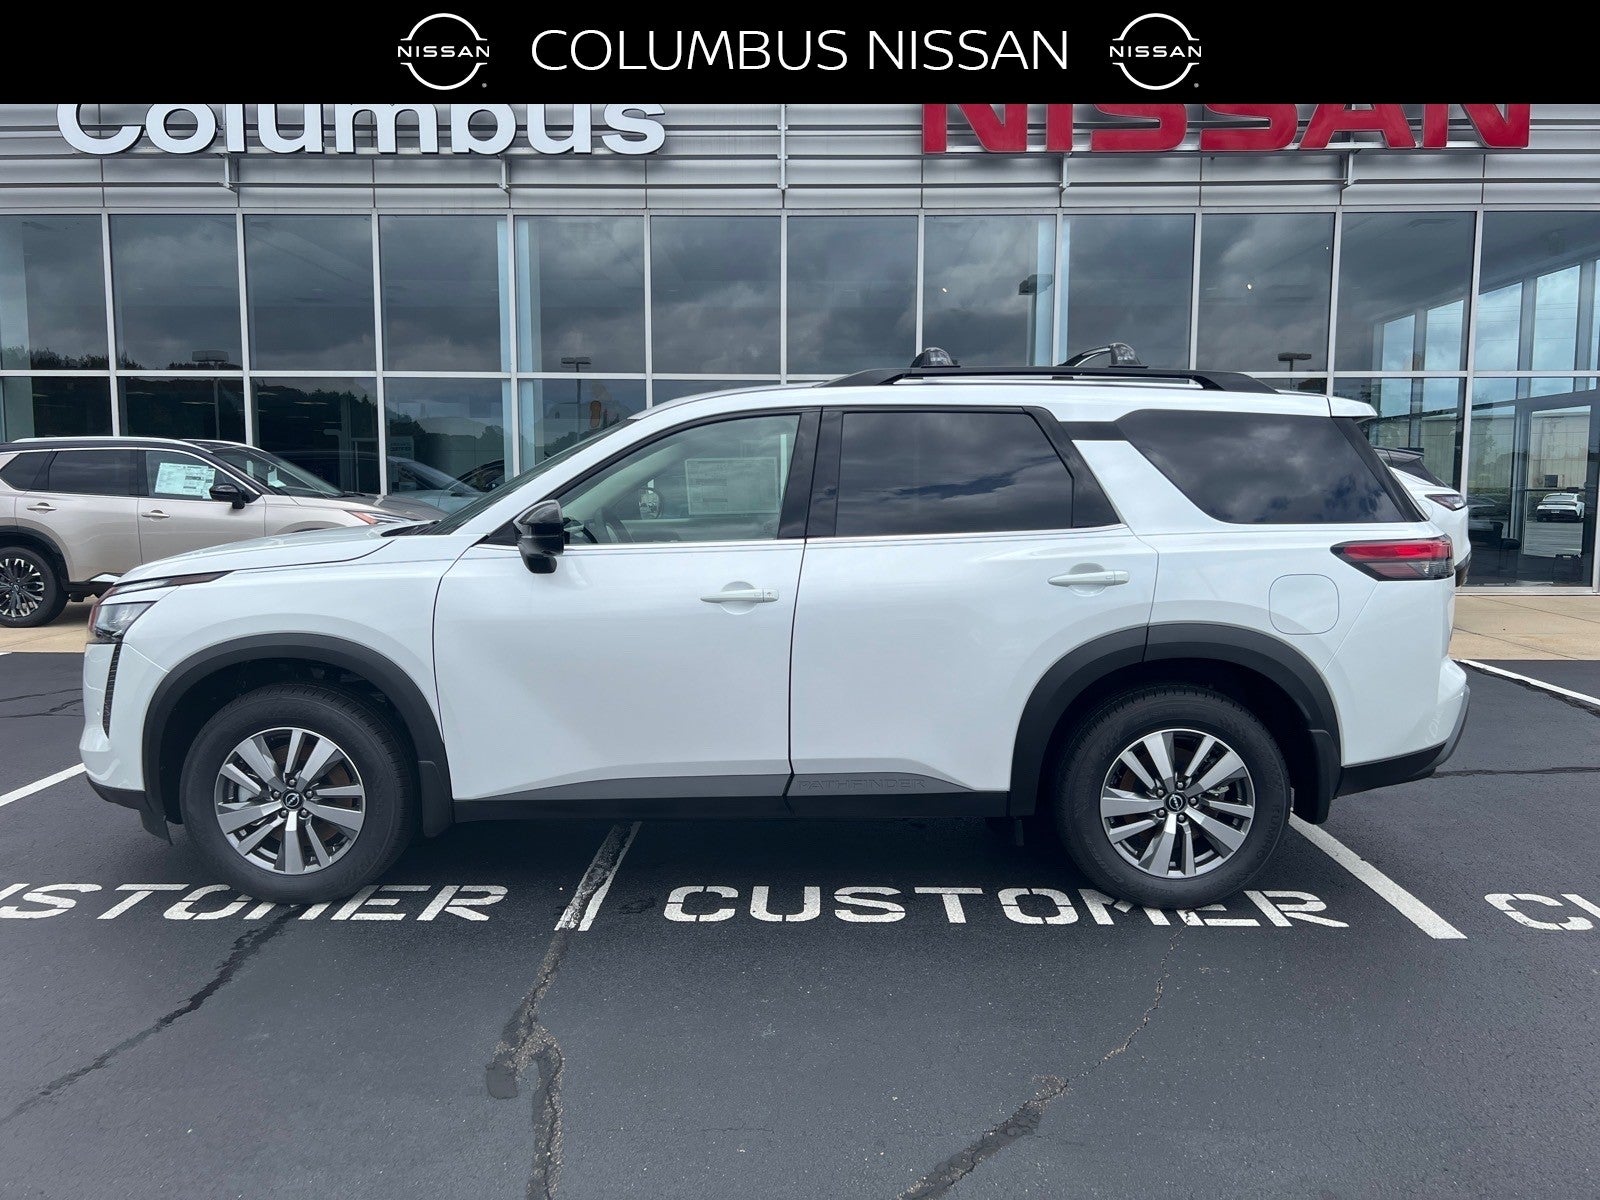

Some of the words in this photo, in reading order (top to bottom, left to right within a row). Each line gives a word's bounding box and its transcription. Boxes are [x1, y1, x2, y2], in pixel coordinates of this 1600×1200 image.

[56, 104, 667, 155] Columbus
[922, 104, 1531, 153] NISSAN
[796, 778, 926, 790] PATHFINDER
